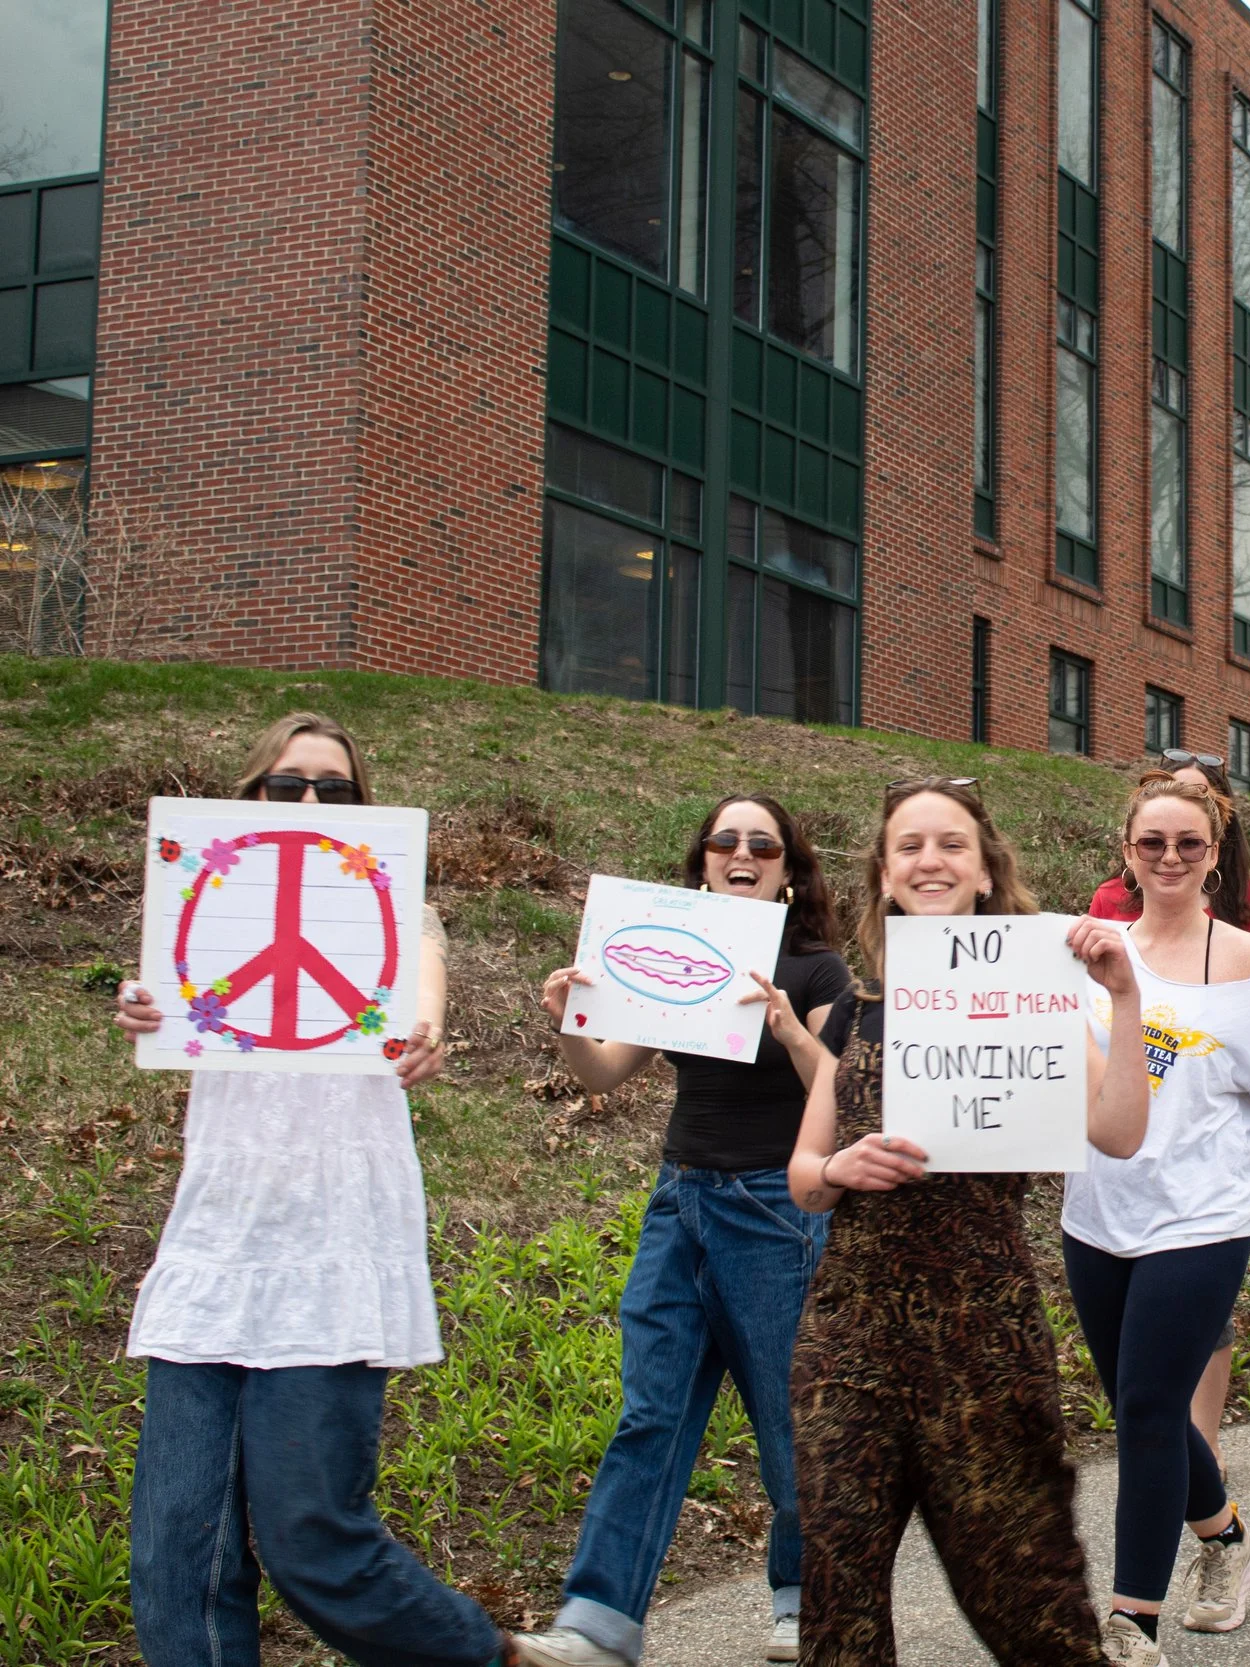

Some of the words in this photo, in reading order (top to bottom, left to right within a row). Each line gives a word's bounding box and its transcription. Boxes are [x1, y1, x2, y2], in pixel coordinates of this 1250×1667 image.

[942, 924, 1012, 969] "NO"
[894, 987, 958, 1010] DOES
[967, 991, 1009, 1019] NOT
[1016, 991, 1079, 1014] MEAN
[1142, 1025, 1162, 1039] TED
[1162, 1033, 1179, 1050] TEA
[1154, 1048, 1172, 1063] TEA
[891, 1040, 1066, 1080] "CONVINCE
[952, 1089, 1014, 1130] ME"
